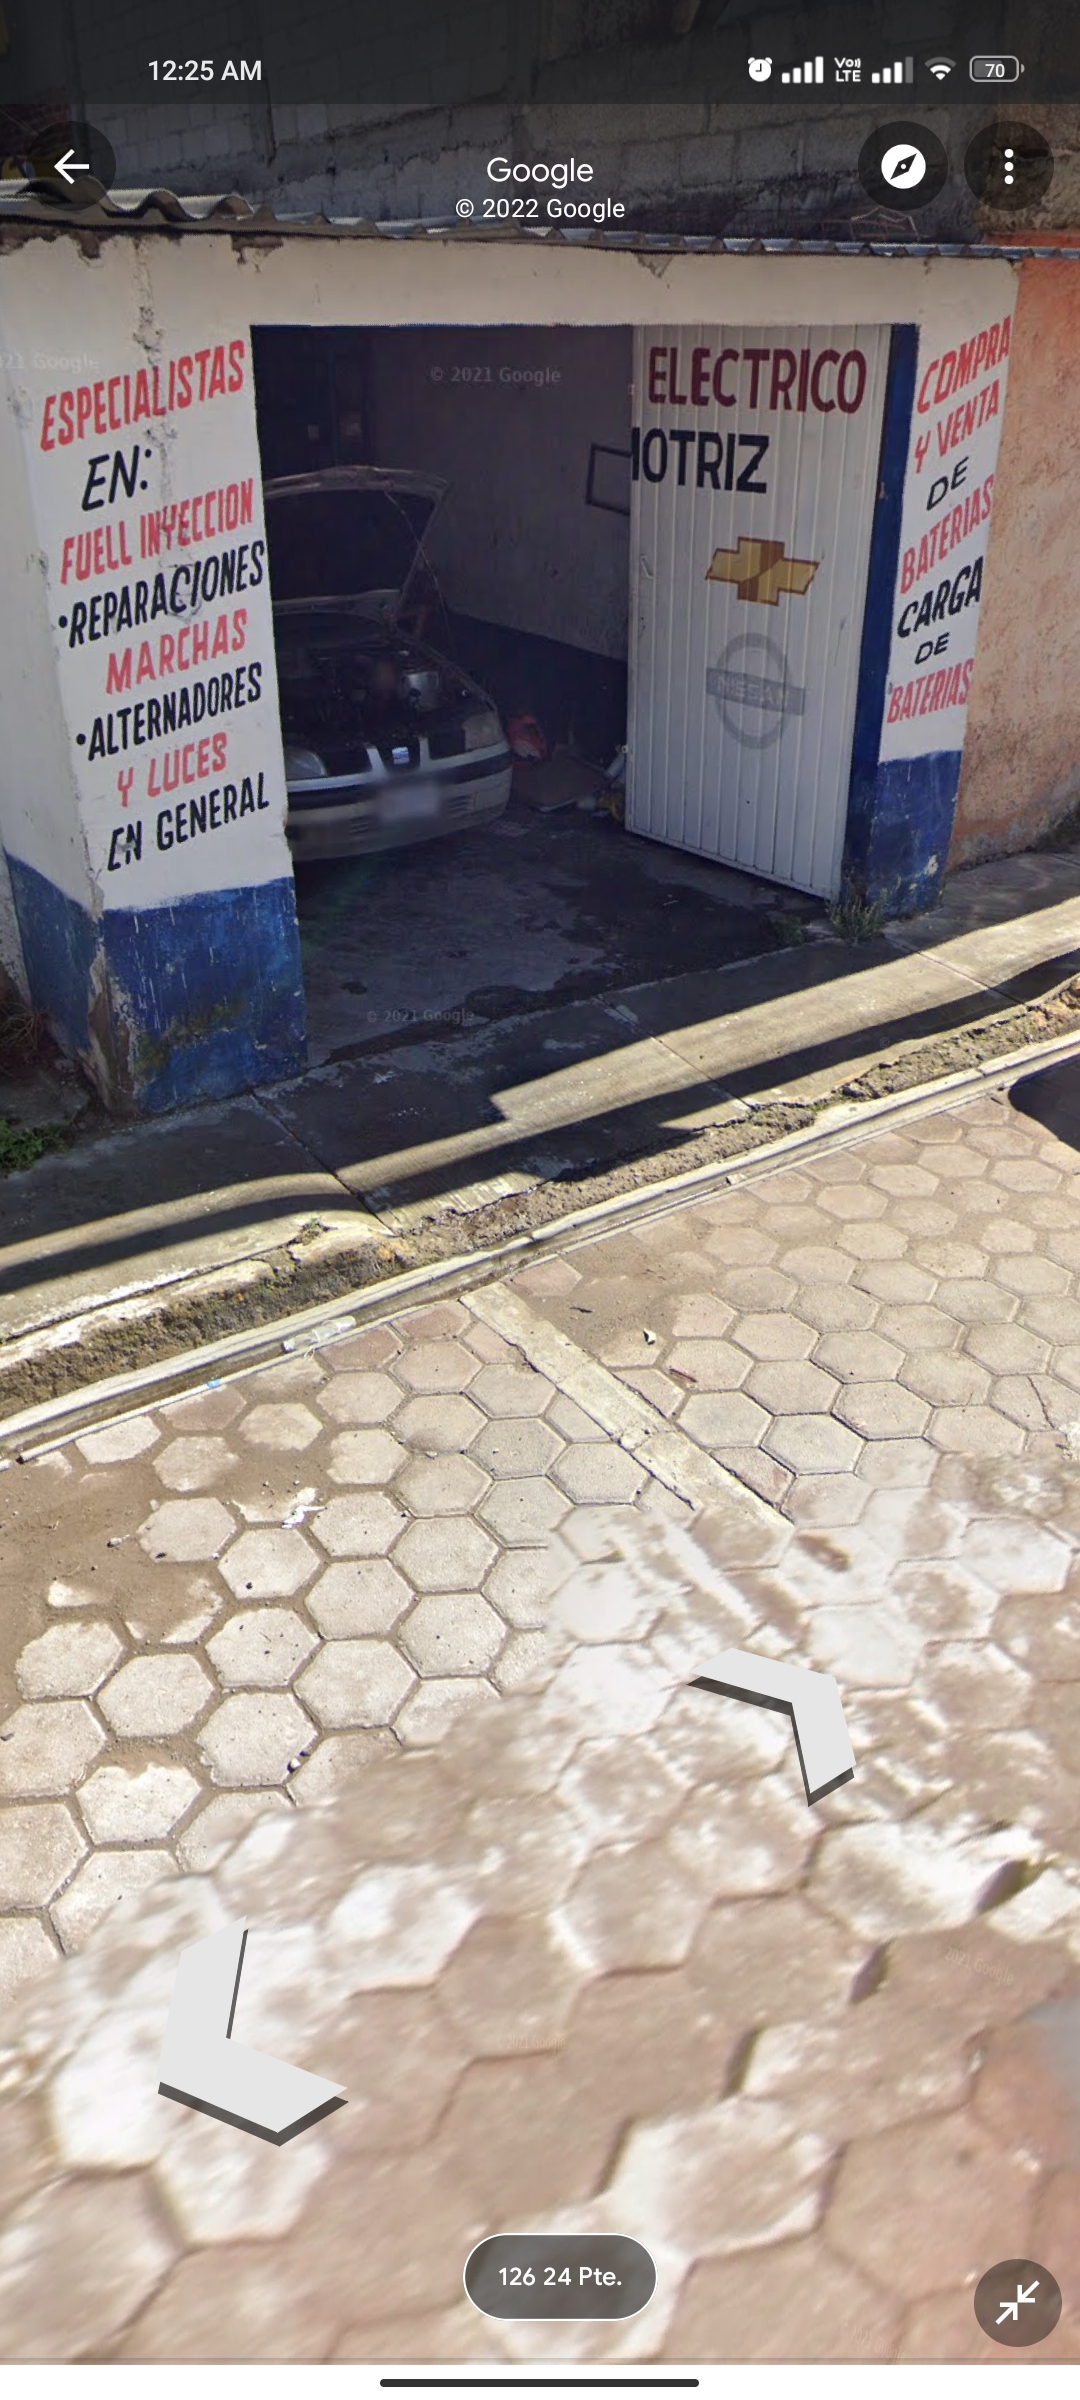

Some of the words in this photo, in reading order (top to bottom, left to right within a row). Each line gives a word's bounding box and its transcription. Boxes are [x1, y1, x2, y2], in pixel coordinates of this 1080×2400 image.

[40, 339, 245, 452] ESPECIALISTAS
[648, 346, 867, 414] ELECTRICO
[917, 315, 1011, 414] COMPRA
[937, 379, 1000, 457] VENTA
[81, 445, 152, 511] EN:
[926, 456, 969, 511] DE
[60, 520, 132, 585] FUELL
[140, 478, 254, 559] INYECCION
[900, 473, 995, 594] BATERIAS
[897, 555, 984, 638] CARGA
[106, 608, 247, 695] MARCHAS
[915, 632, 950, 665] DE
[887, 657, 975, 724] BATERIAS
[117, 767, 134, 808] Y
[147, 732, 228, 798] LUCES
[107, 820, 143, 871] EN
[156, 772, 269, 850] GENERAL
